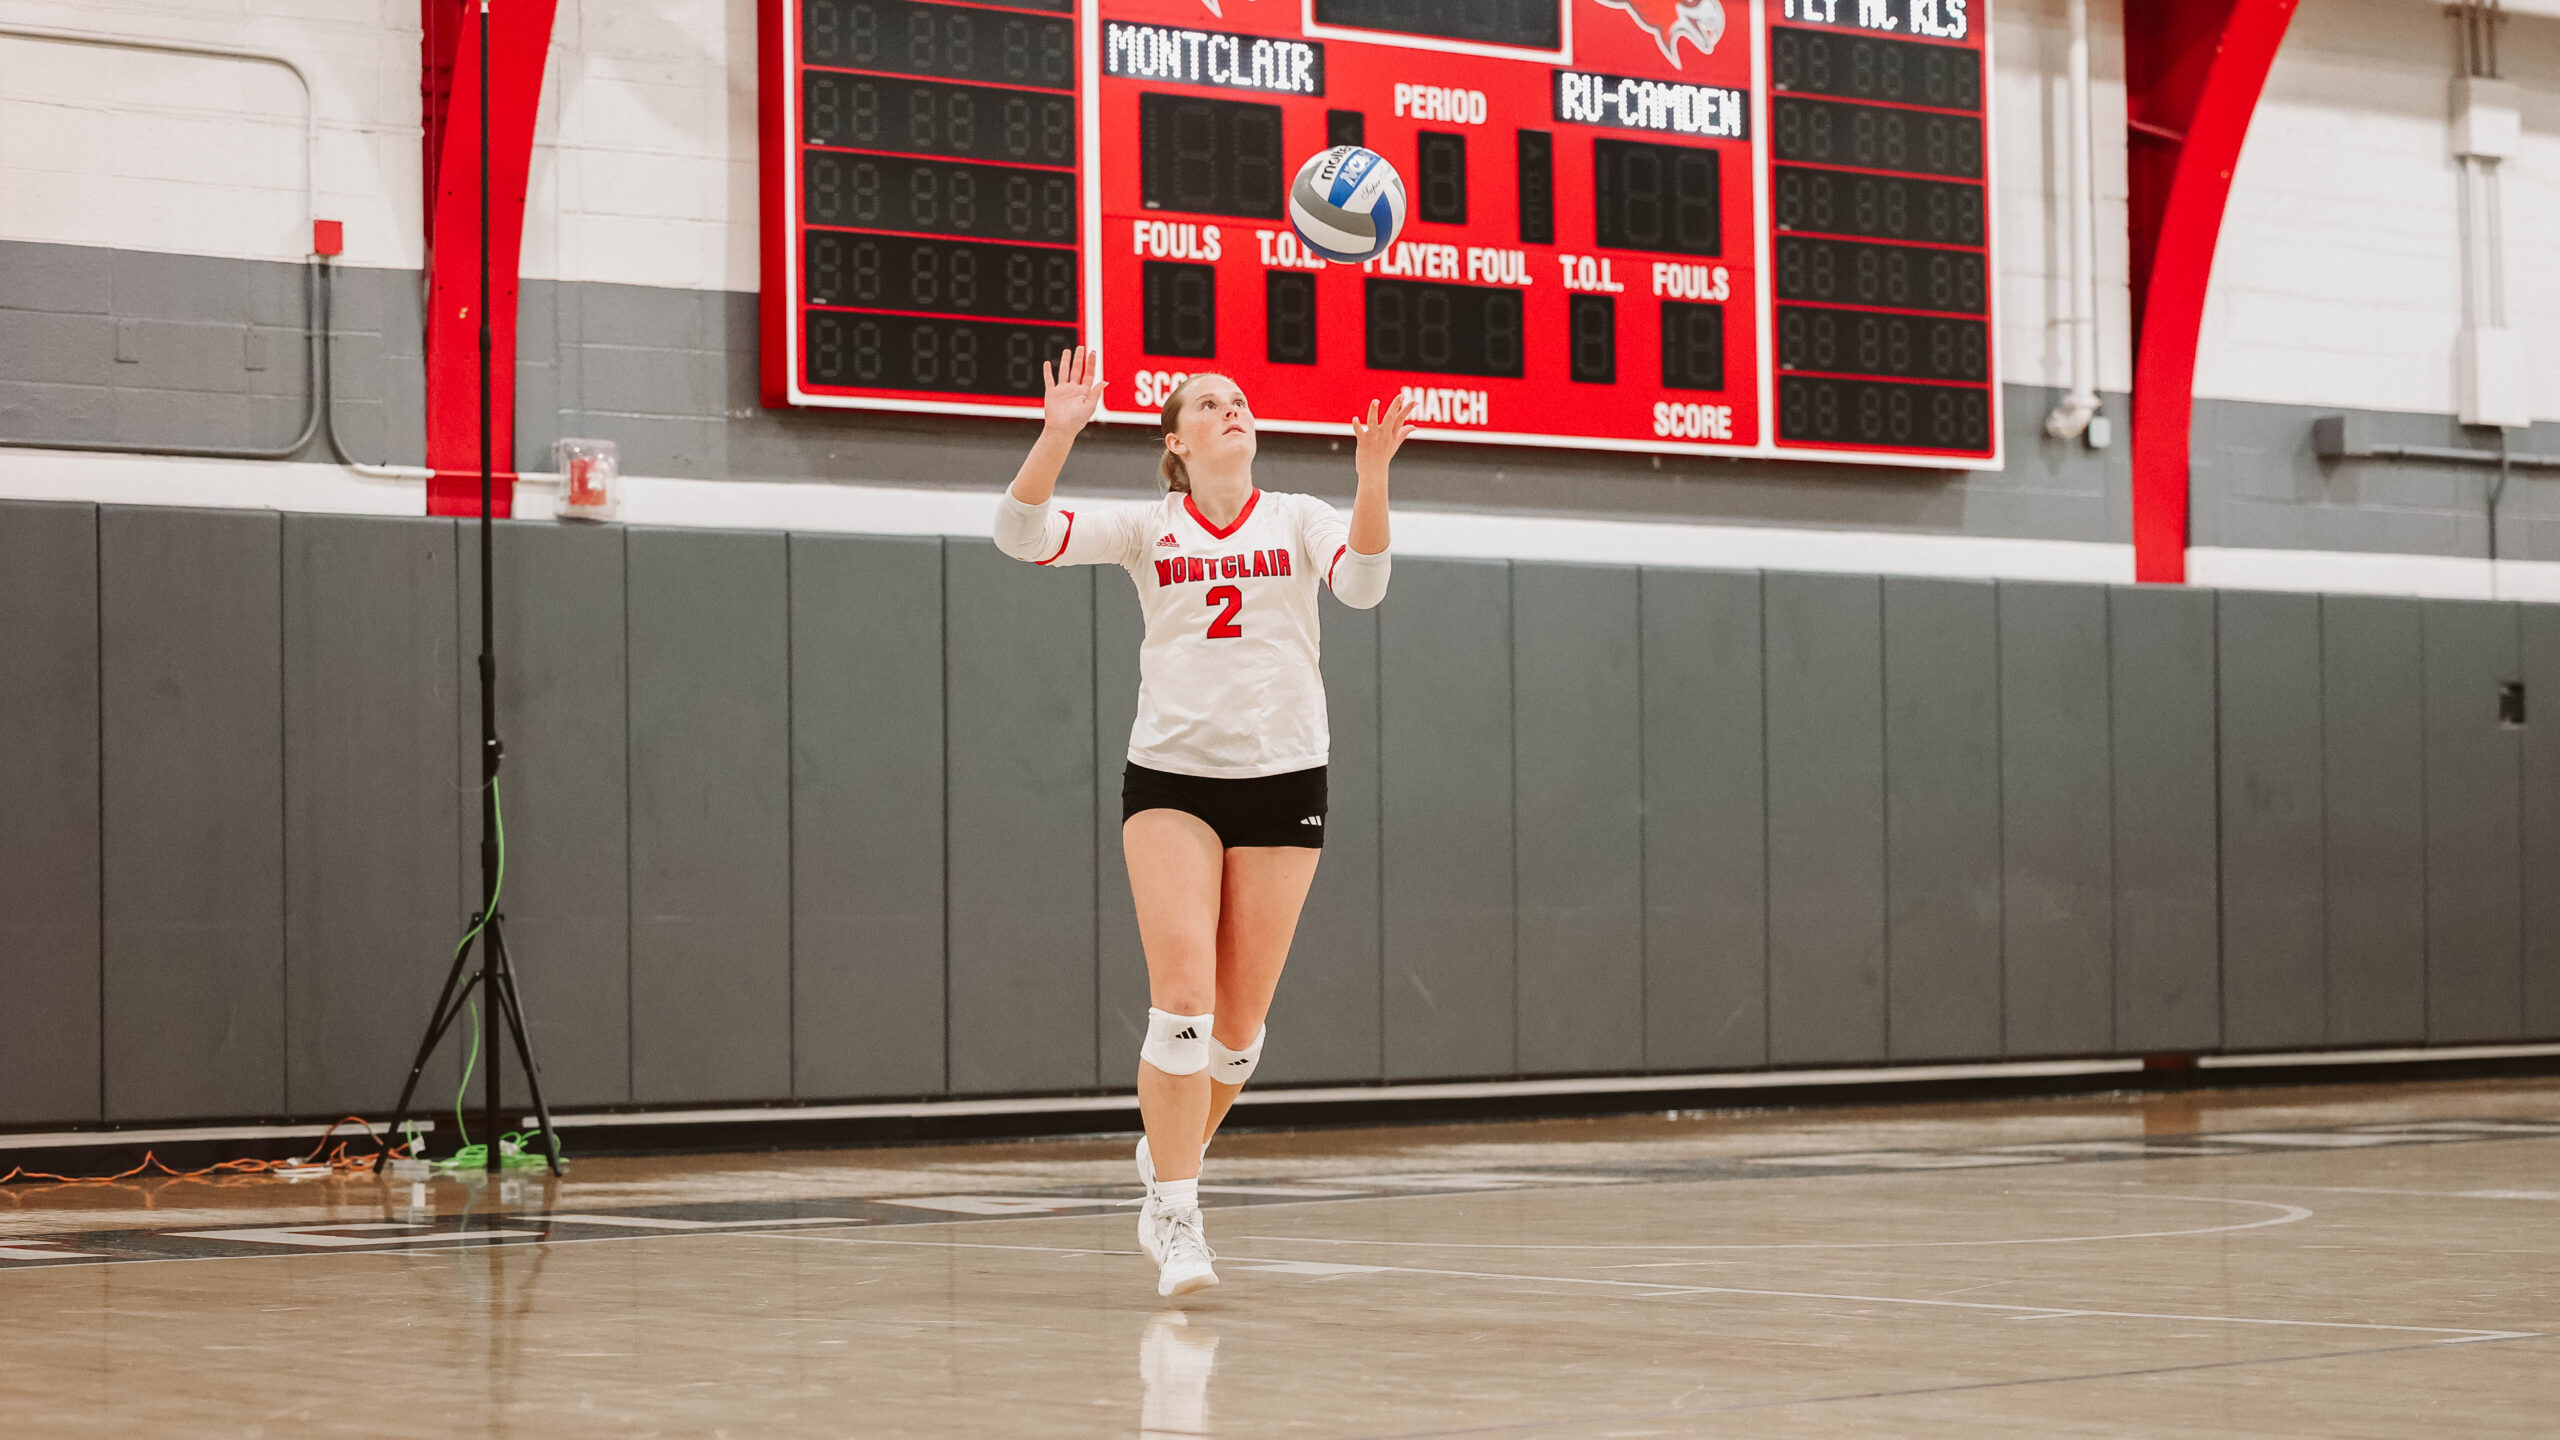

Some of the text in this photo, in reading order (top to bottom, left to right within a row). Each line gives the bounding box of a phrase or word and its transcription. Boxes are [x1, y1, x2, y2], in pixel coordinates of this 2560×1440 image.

[1108, 23, 1313, 92] MONTCLAIR
[1394, 82, 1487, 125] PERIOD
[1562, 72, 1741, 136] RU-CAMDEN
[1133, 219, 1222, 262] FOULS
[1467, 246, 1533, 286] FOUL
[1558, 254, 1625, 293] T.O.L.
[1652, 262, 1730, 302] FOULS
[1400, 386, 1488, 425] MATCH
[1653, 401, 1733, 440] SCORE
[1154, 548, 1291, 587] MONTCLAIR
[1206, 585, 1242, 639] 2
